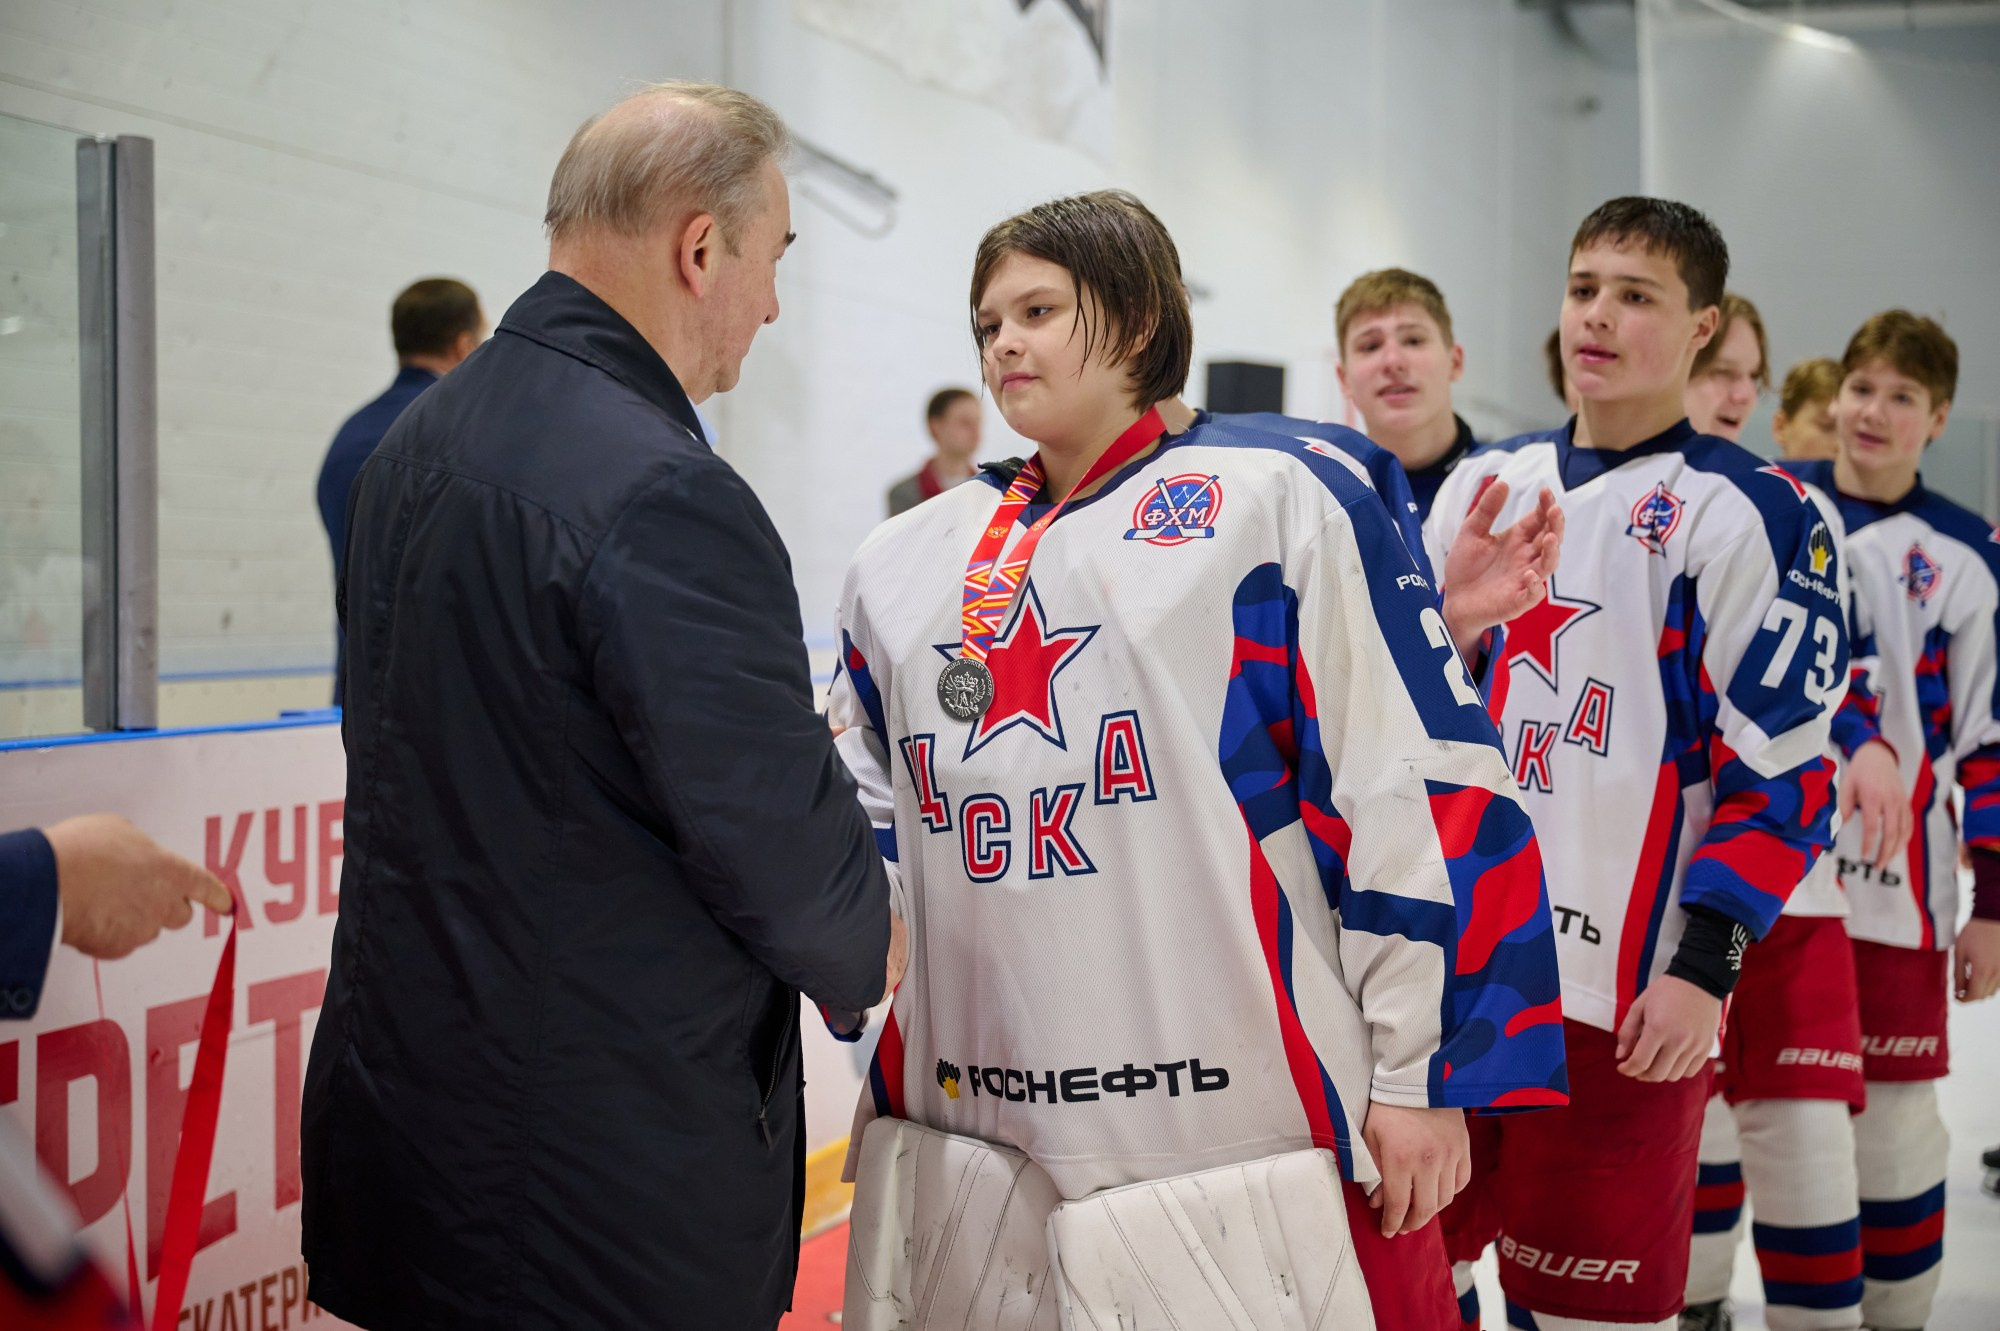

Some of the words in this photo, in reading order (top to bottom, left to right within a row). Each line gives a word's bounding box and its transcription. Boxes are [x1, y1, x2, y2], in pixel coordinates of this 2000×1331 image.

[1143, 506, 1209, 527] ФХМ
[1760, 597, 1839, 706] 73
[1500, 676, 1615, 794] КА
[898, 709, 1157, 884] ЦСКА
[967, 1058, 1230, 1104] РОСНЕФТЬ
[1501, 1235, 1640, 1284] BAUER
